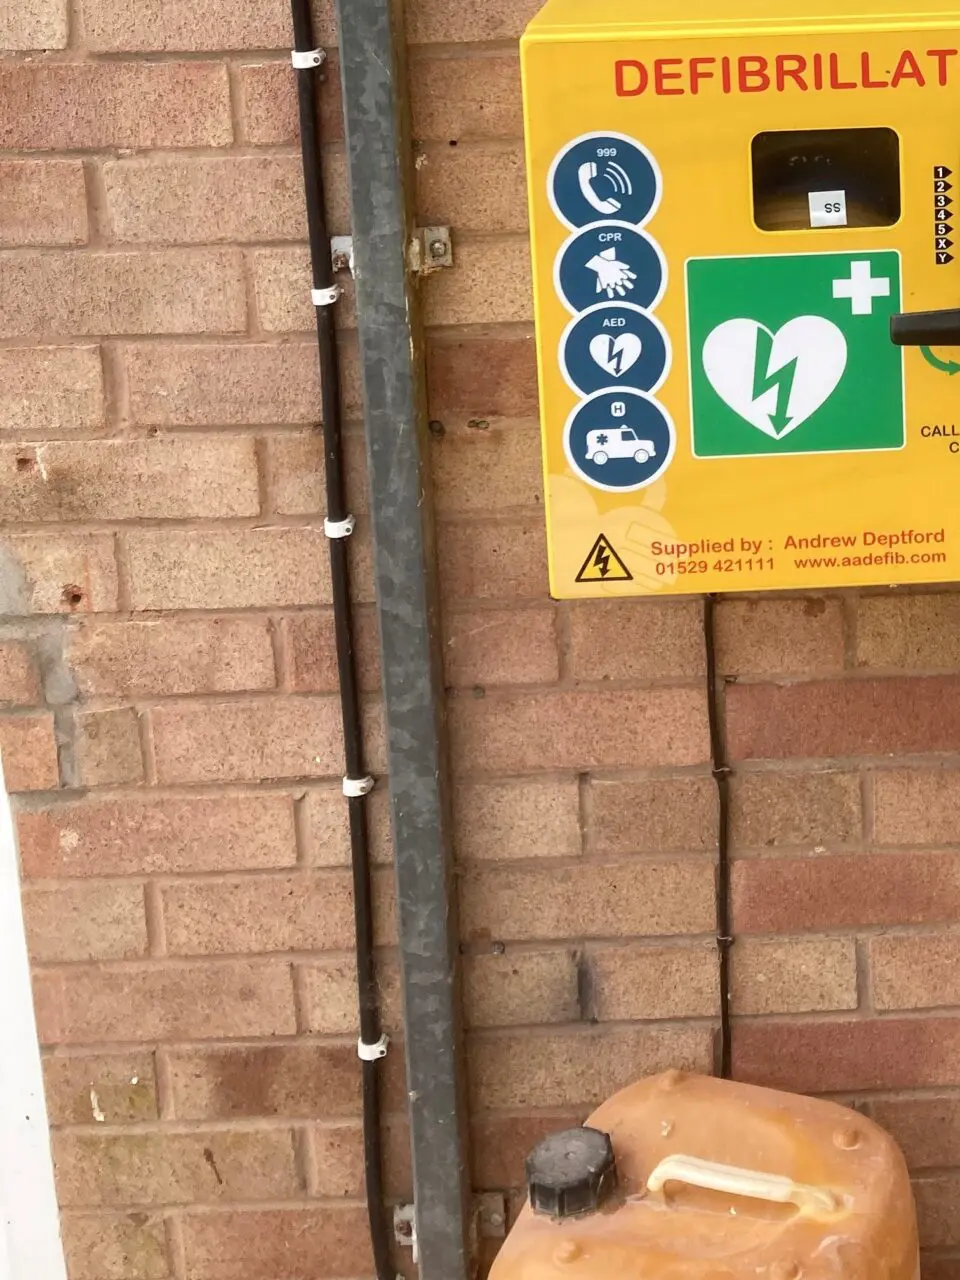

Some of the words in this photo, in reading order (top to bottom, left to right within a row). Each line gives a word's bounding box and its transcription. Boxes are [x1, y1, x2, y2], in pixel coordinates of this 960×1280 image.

[596, 148, 617, 157] 999
[937, 167, 943, 178] 1
[937, 182, 945, 192] 2
[937, 196, 945, 206] 3
[937, 210, 946, 220] 4
[938, 224, 946, 234] 5
[598, 232, 622, 242] CPR
[938, 239, 947, 249] X
[938, 253, 947, 263] Y
[602, 318, 626, 327] AED
[920, 424, 960, 438] CALL
[651, 538, 735, 558] Supplied
[740, 537, 762, 555] by
[783, 534, 857, 550] Andrew
[862, 528, 946, 550] Deptford
[655, 560, 709, 576] 01529
[713, 557, 775, 574] 421111
[793, 550, 947, 569] www.aadefib.com
